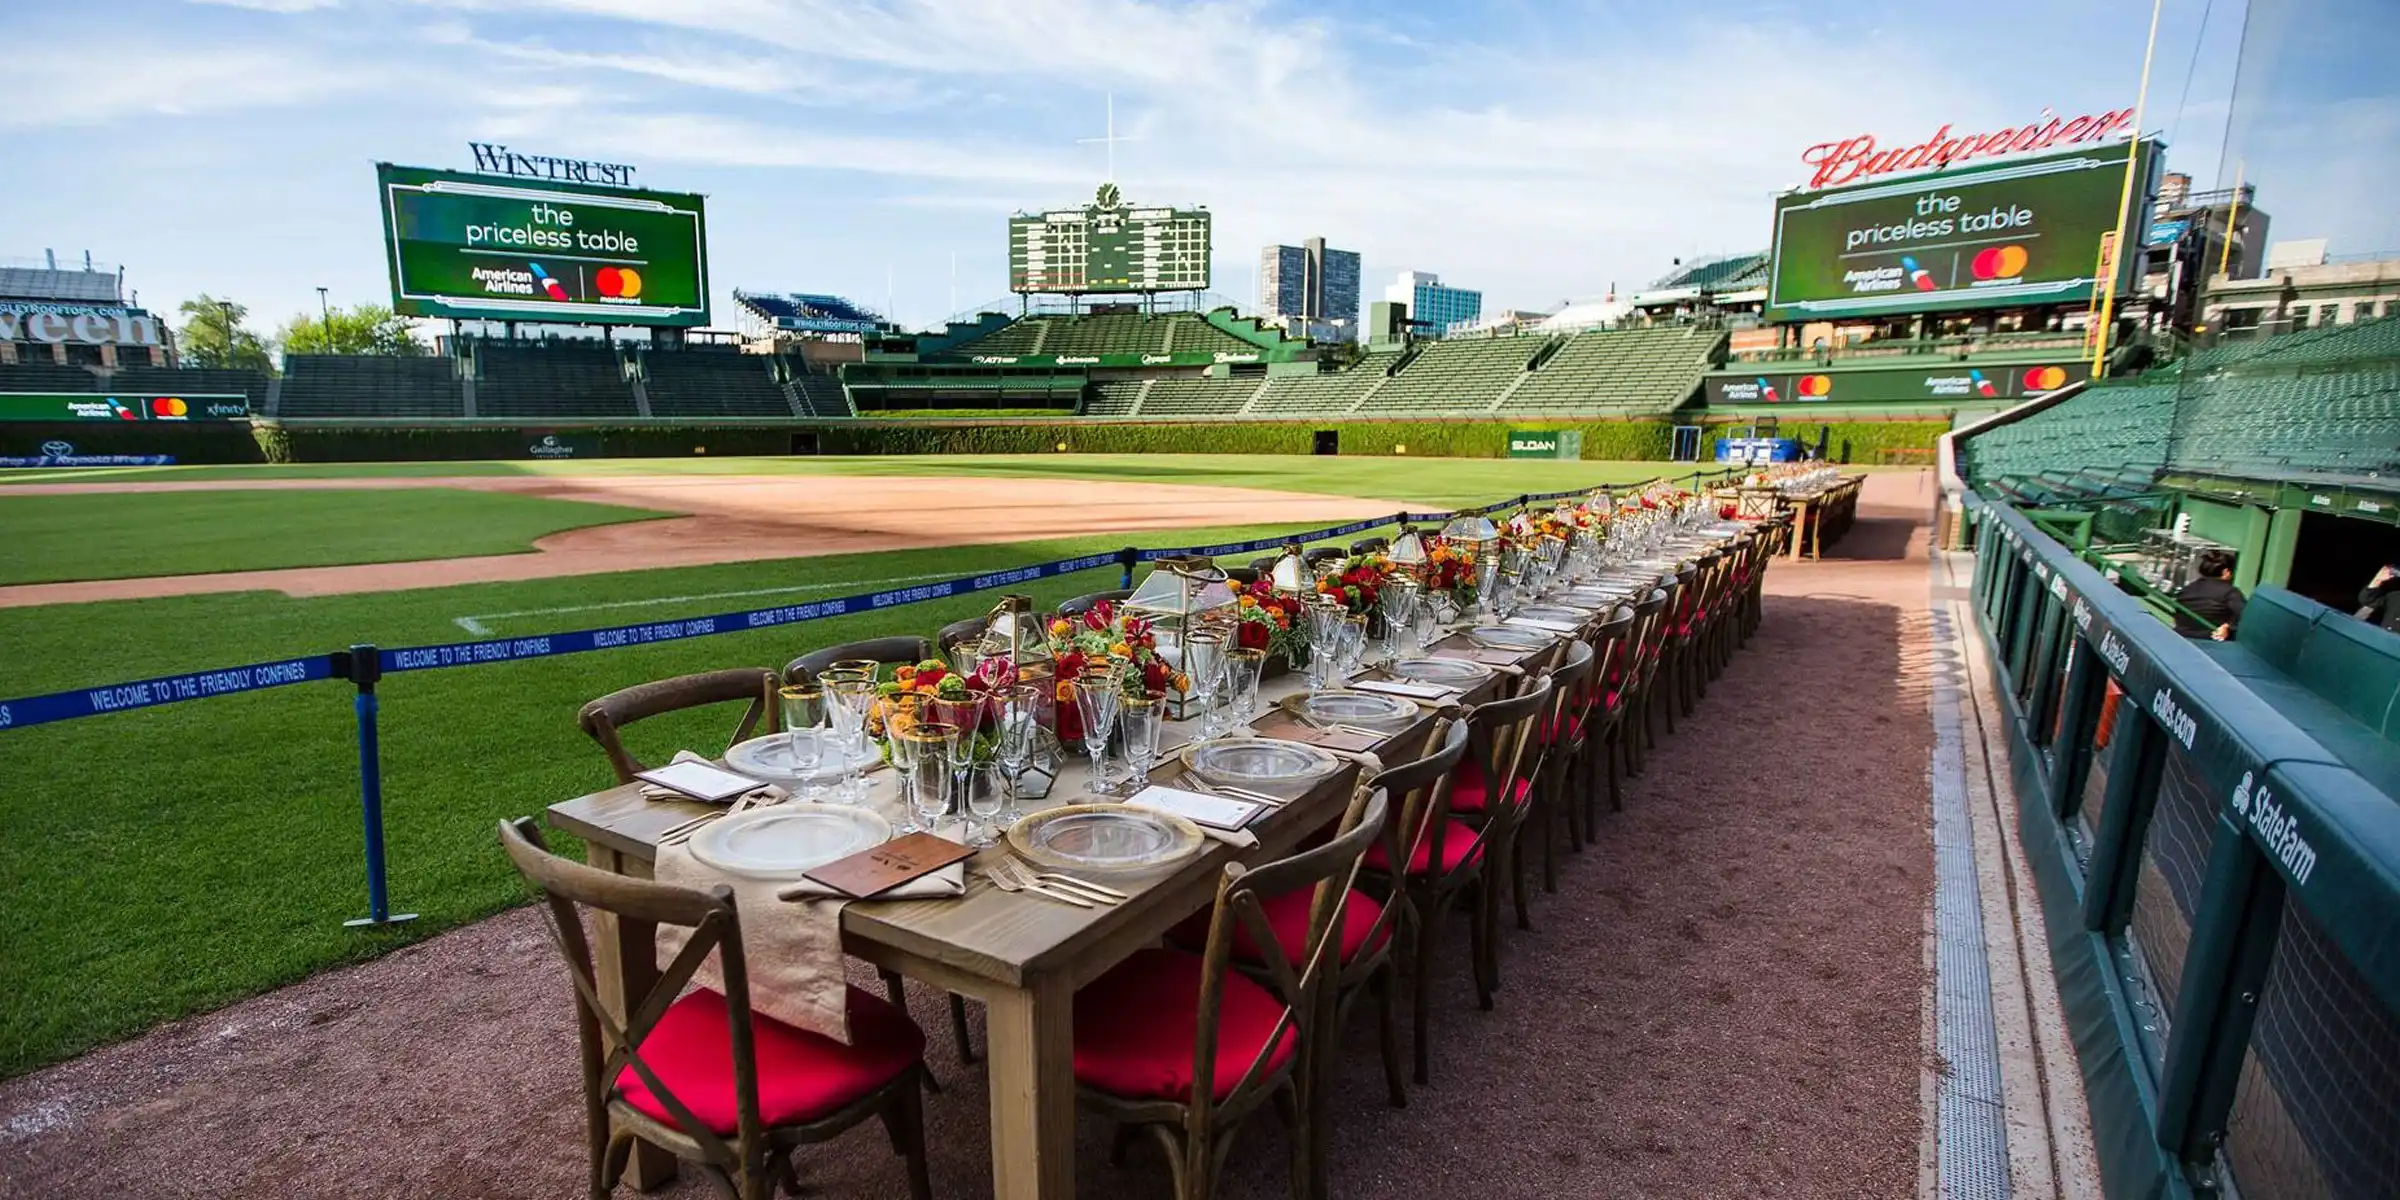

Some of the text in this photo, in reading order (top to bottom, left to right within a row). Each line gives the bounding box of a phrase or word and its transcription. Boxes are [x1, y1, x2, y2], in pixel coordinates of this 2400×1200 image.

[1802, 106, 2134, 189] Budweiser
[531, 203, 573, 226] the
[1915, 192, 1961, 216] the
[466, 222, 639, 253] priceless table
[1846, 204, 2033, 250] priceless table
[472, 267, 533, 283] American
[485, 280, 533, 295] Airlines
[1843, 267, 1903, 283] American
[206, 402, 246, 417] xfinity
[1511, 440, 1556, 451] SLOAN
[593, 618, 716, 647] WELCOME TO THE FRIENDLY CONFINES
[394, 637, 551, 669] WELCOME TO THE FRIENDLY CONFINES
[90, 662, 306, 711] WELCOME TO THE FRIENDLY CONFINES
[2152, 688, 2197, 750] cubs.com
[2249, 785, 2317, 886] StateFarm
